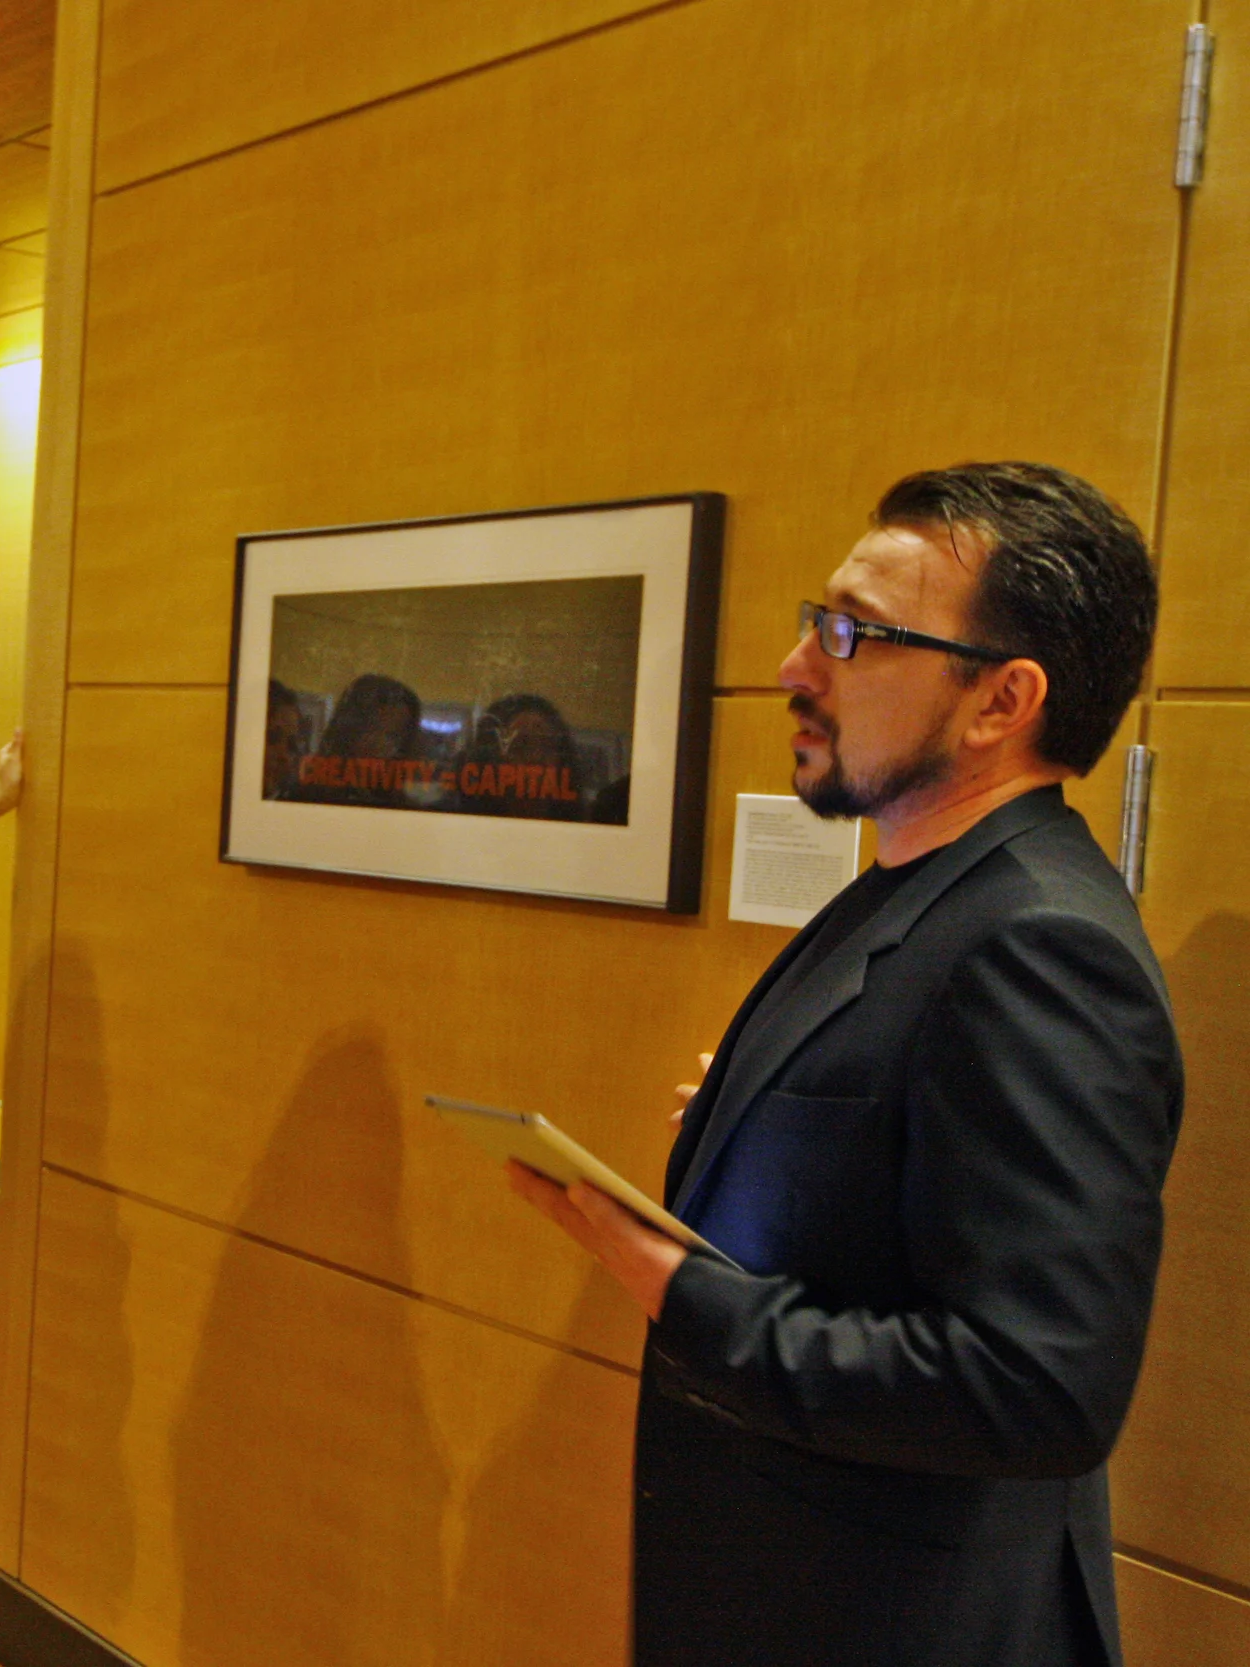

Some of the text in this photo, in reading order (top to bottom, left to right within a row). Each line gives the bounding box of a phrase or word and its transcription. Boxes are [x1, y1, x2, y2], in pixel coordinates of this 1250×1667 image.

[299, 756, 578, 801] CREATIVITY = CAPITAL
